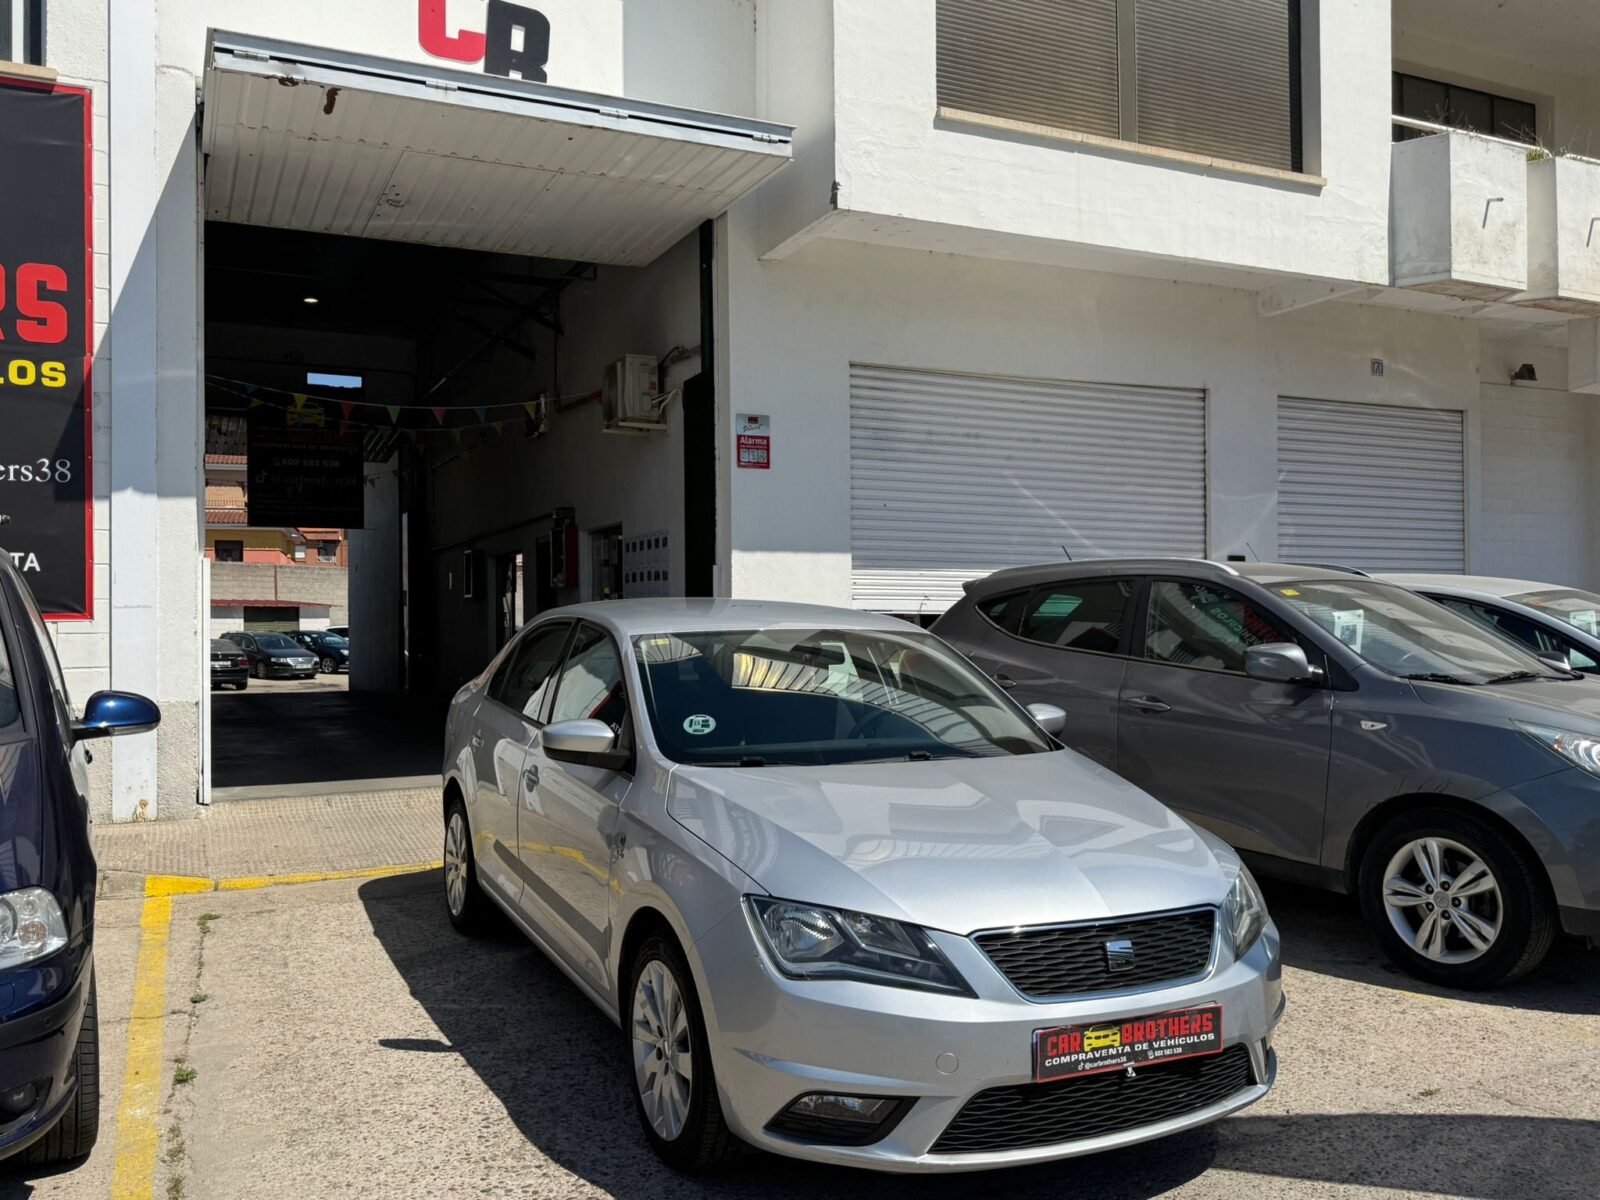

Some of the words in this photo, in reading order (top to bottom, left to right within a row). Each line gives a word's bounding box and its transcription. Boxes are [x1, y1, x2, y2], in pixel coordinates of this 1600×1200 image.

[0, 262, 68, 344] S
[0, 359, 67, 388] OS
[739, 436, 767, 446] Alarma
[1044, 1045, 1131, 1067] COMPRAVENTA
[1134, 1042, 1149, 1051] DE
[1152, 1033, 1215, 1049] VEHÍCULOS
[1046, 1031, 1081, 1057] CAR
[1121, 1013, 1213, 1044] BROTHERS
